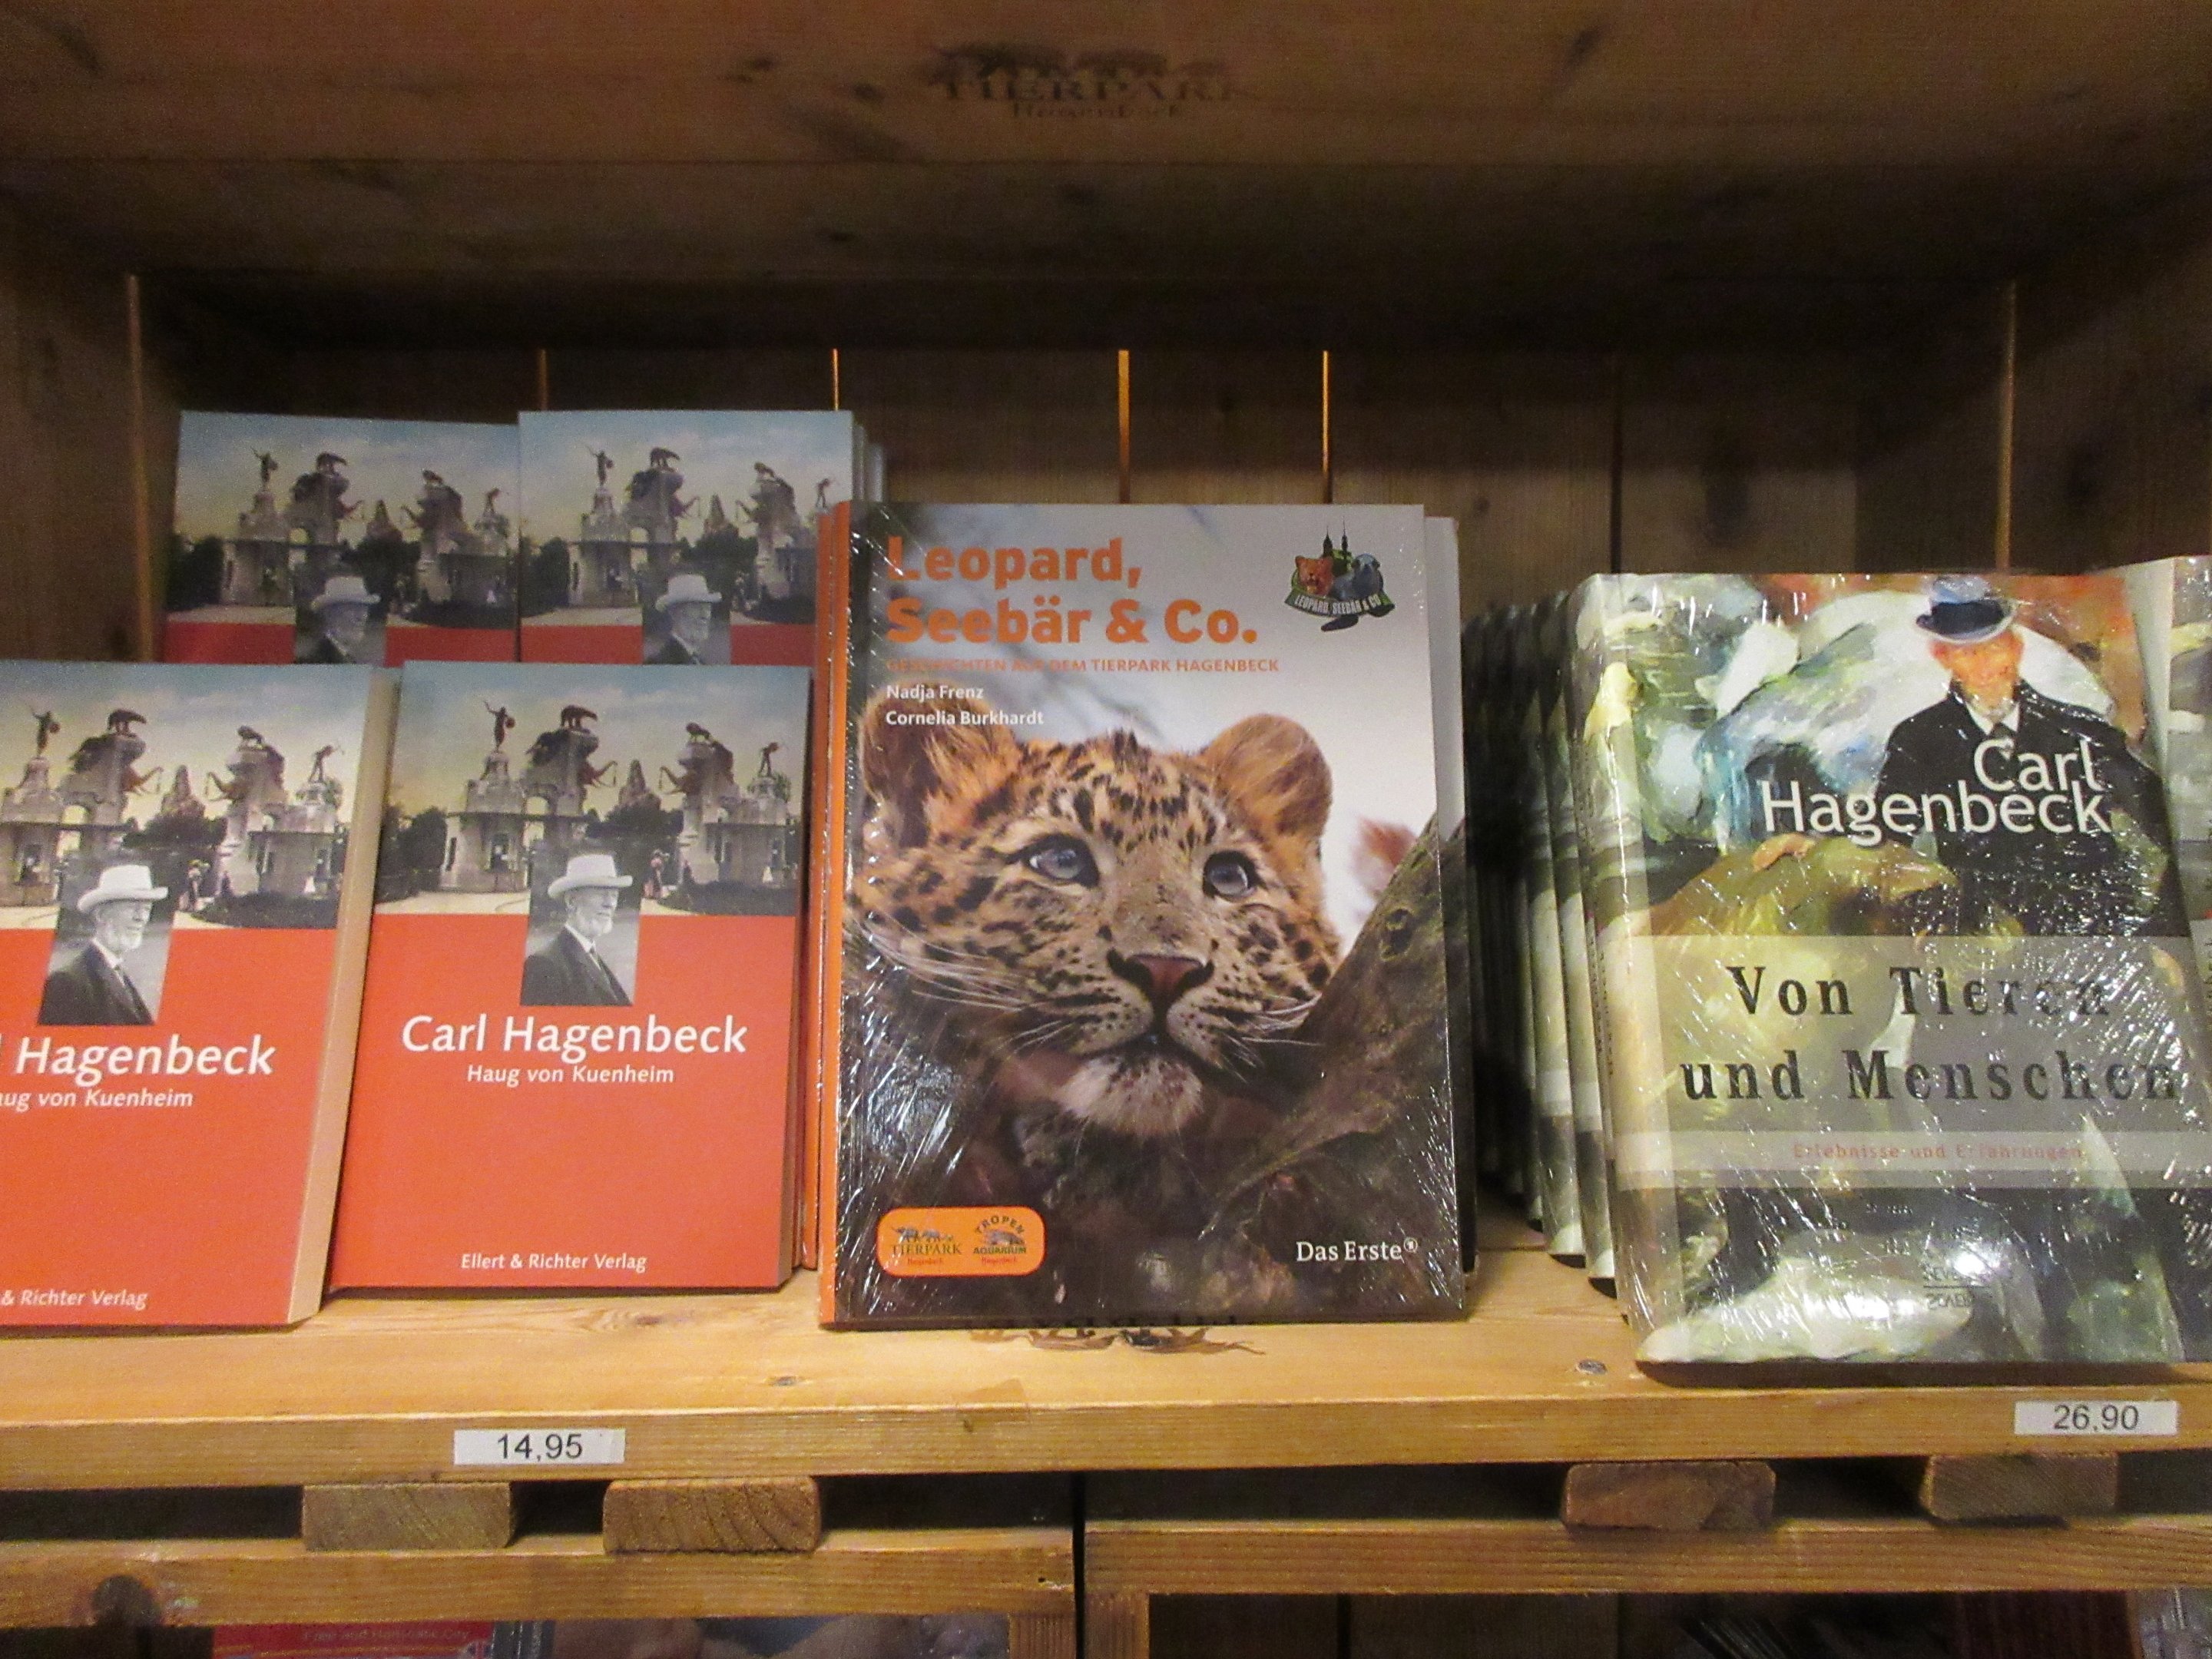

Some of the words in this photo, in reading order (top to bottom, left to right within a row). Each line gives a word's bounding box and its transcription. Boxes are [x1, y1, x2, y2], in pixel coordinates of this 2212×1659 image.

[887, 535, 1142, 590] Leopard,
[887, 595, 1091, 644] Seebär
[1105, 598, 1149, 644] &
[1164, 598, 1258, 644] Co.
[1050, 659, 1087, 672] DEM
[1092, 659, 1171, 672] TIERPARK
[1176, 659, 1280, 672] HAGENBECK
[886, 685, 935, 702] Nadja
[939, 685, 985, 700] Frenz
[886, 710, 956, 726] Cornelia
[960, 710, 1045, 726] Burkhardt
[1974, 739, 2106, 792] Carl
[1760, 780, 2113, 847] Hagenbeck
[1727, 965, 1853, 1016] Von
[1889, 965, 2111, 1016] Tieren
[402, 1013, 486, 1053] Carl
[503, 1014, 748, 1064] Hagenbeck
[15, 1034, 276, 1088] Hagenbeck
[1681, 1050, 1805, 1101] und
[1842, 1049, 2180, 1101] Menschen
[466, 1065, 521, 1088] Haug
[527, 1068, 564, 1083] von
[572, 1065, 674, 1084] Kuenheim
[38, 1091, 77, 1107] von
[84, 1089, 194, 1107] Kuenheim
[461, 1253, 505, 1270] Ellert
[510, 1253, 523, 1270] &
[528, 1253, 588, 1270] Richter
[594, 1253, 648, 1273] Verlag
[1296, 1240, 1339, 1262] Das
[1344, 1240, 1402, 1262] Erste
[2, 1290, 15, 1306] &
[21, 1290, 85, 1306] Richter
[91, 1290, 148, 1311] Verlag
[497, 1432, 584, 1462] 14,95
